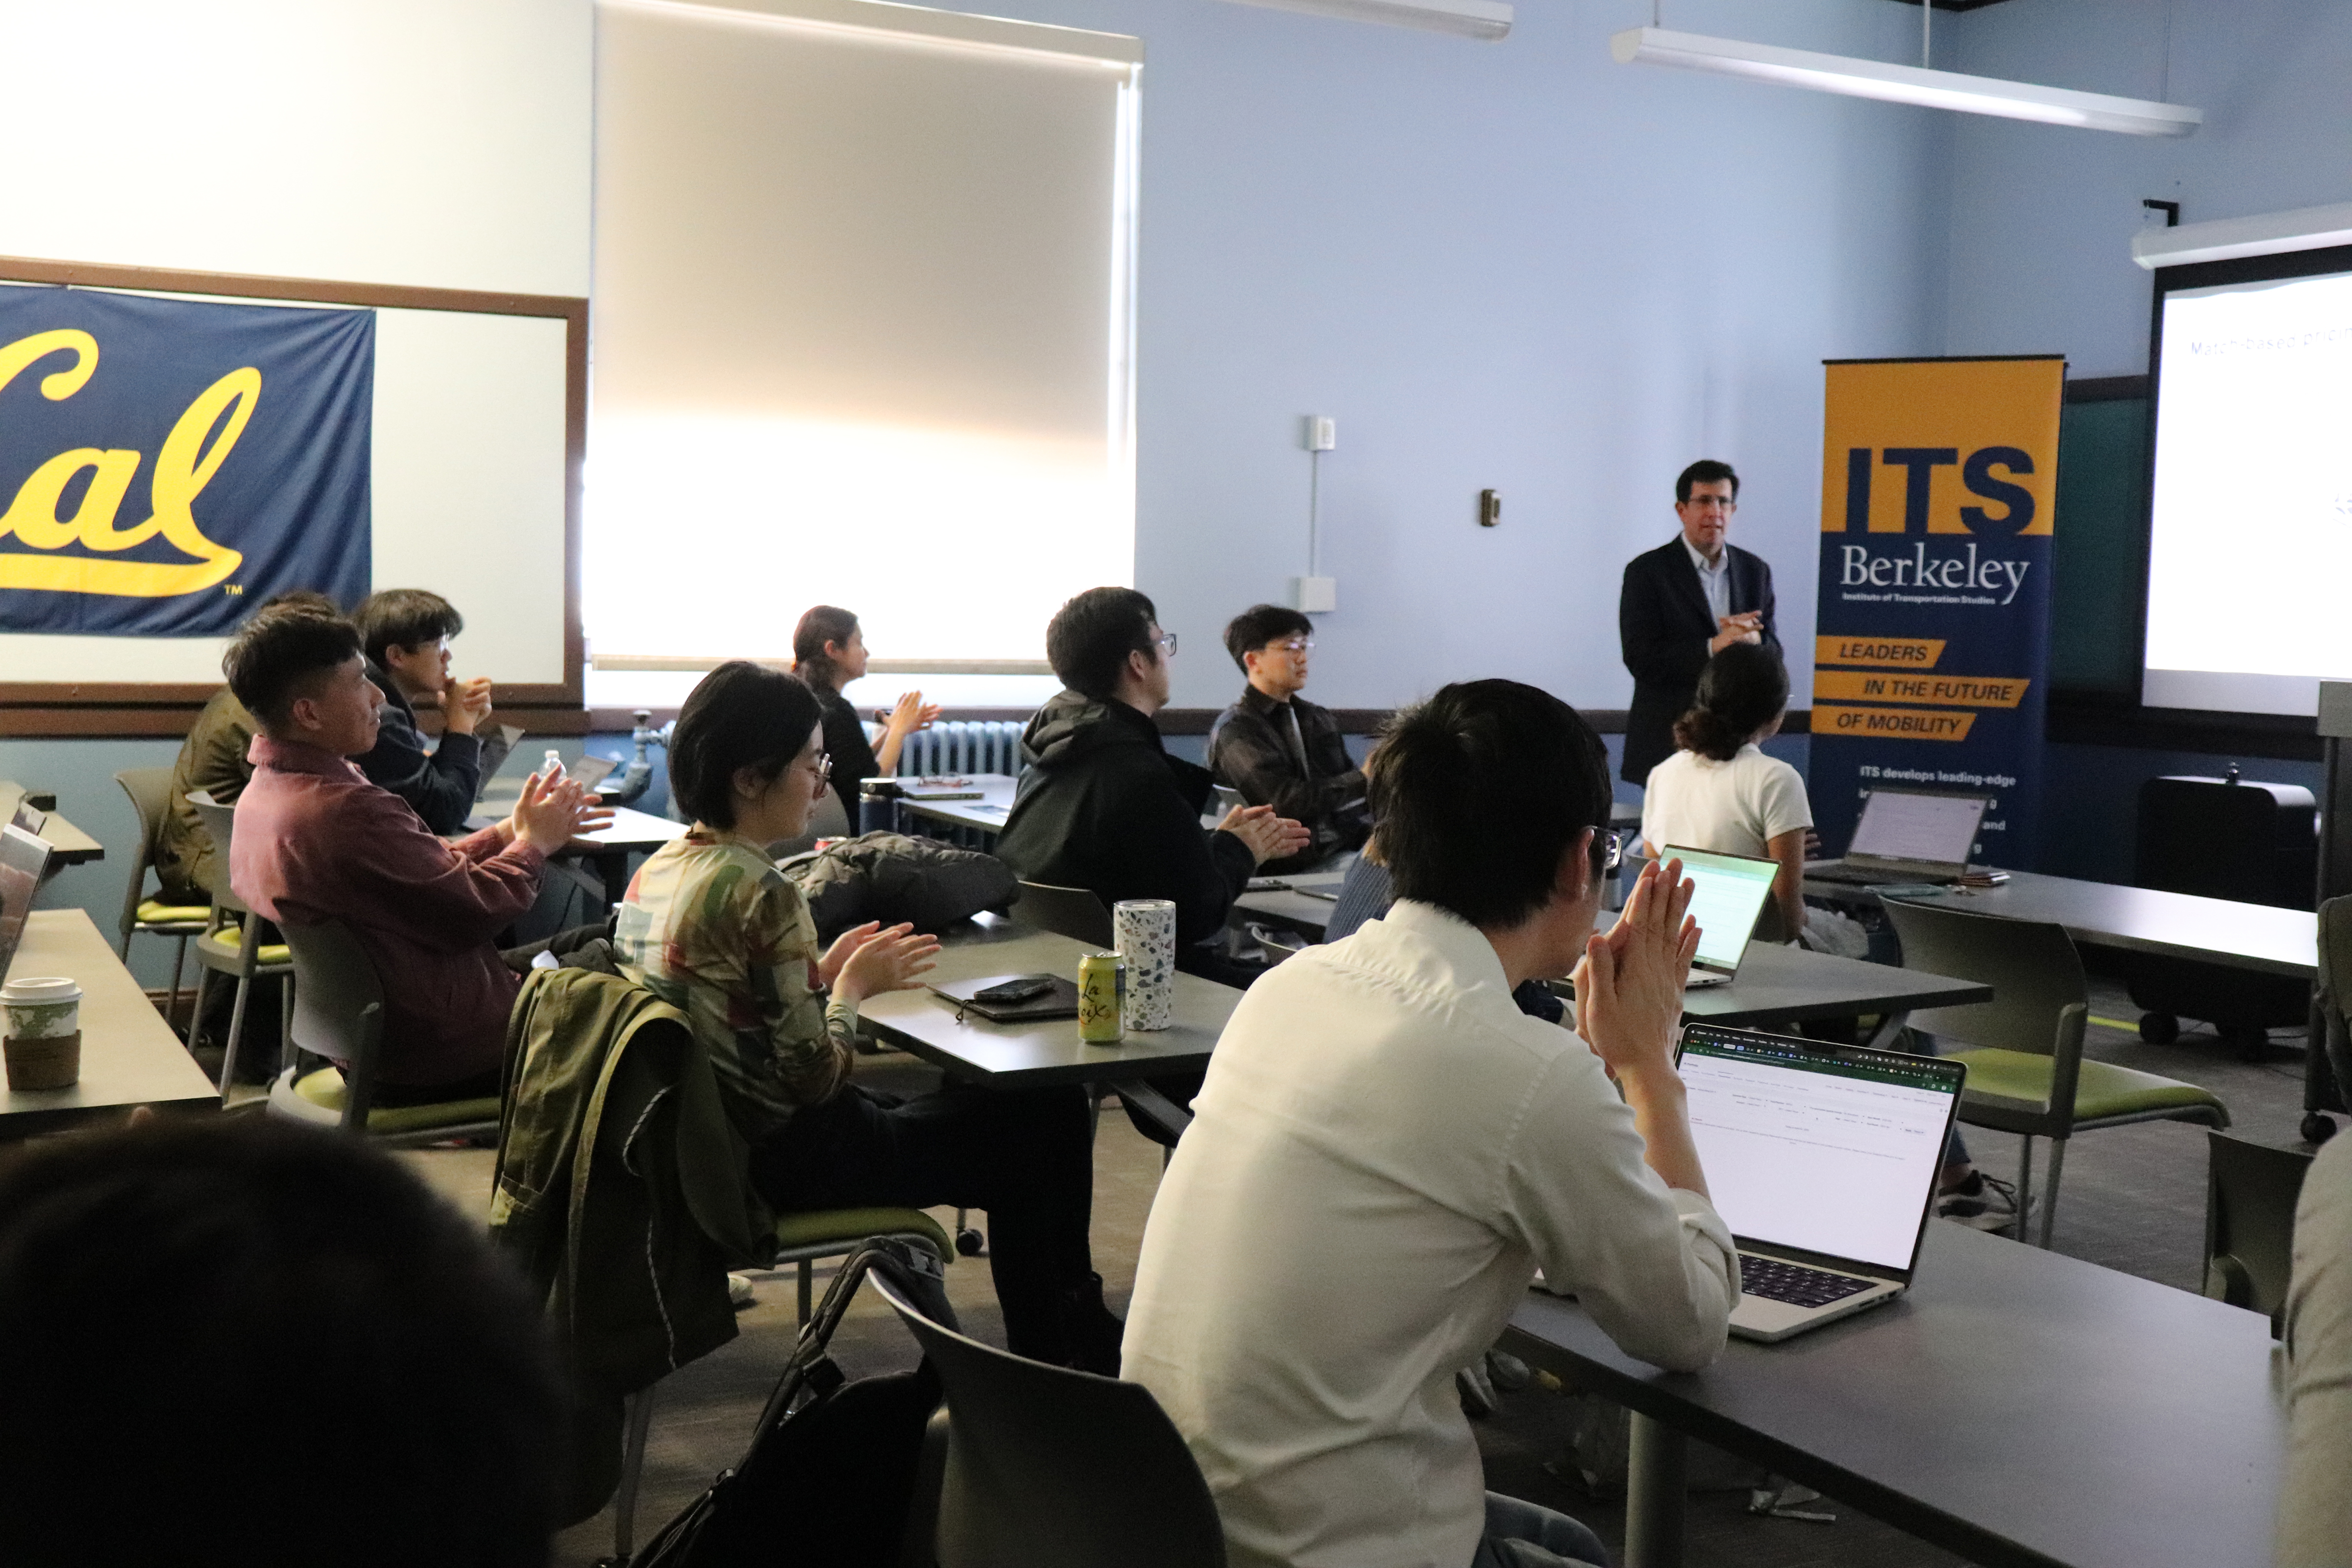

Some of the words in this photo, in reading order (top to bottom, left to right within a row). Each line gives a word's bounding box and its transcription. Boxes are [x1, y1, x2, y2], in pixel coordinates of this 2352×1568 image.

[2191, 332, 2296, 356] Match-based
[1845, 446, 2035, 538] ITS
[1840, 541, 2032, 606] Berkeley
[224, 584, 243, 595] TM
[1842, 592, 1881, 601] Institute
[1882, 593, 1893, 602] of
[1894, 593, 1960, 604] Transportation
[1961, 595, 1996, 605] Studies
[1840, 643, 1929, 661] LEADERS
[1864, 679, 1886, 695] IN
[1892, 680, 1930, 697] THE
[1933, 682, 2013, 701] FUTURE
[1837, 712, 1863, 729] OF
[1867, 714, 1962, 734] MOBILITY
[1860, 765, 1880, 778] ITS
[1882, 767, 1936, 783] develops
[1937, 770, 2017, 787] leading-edge
[1081, 973, 1099, 1003] La
